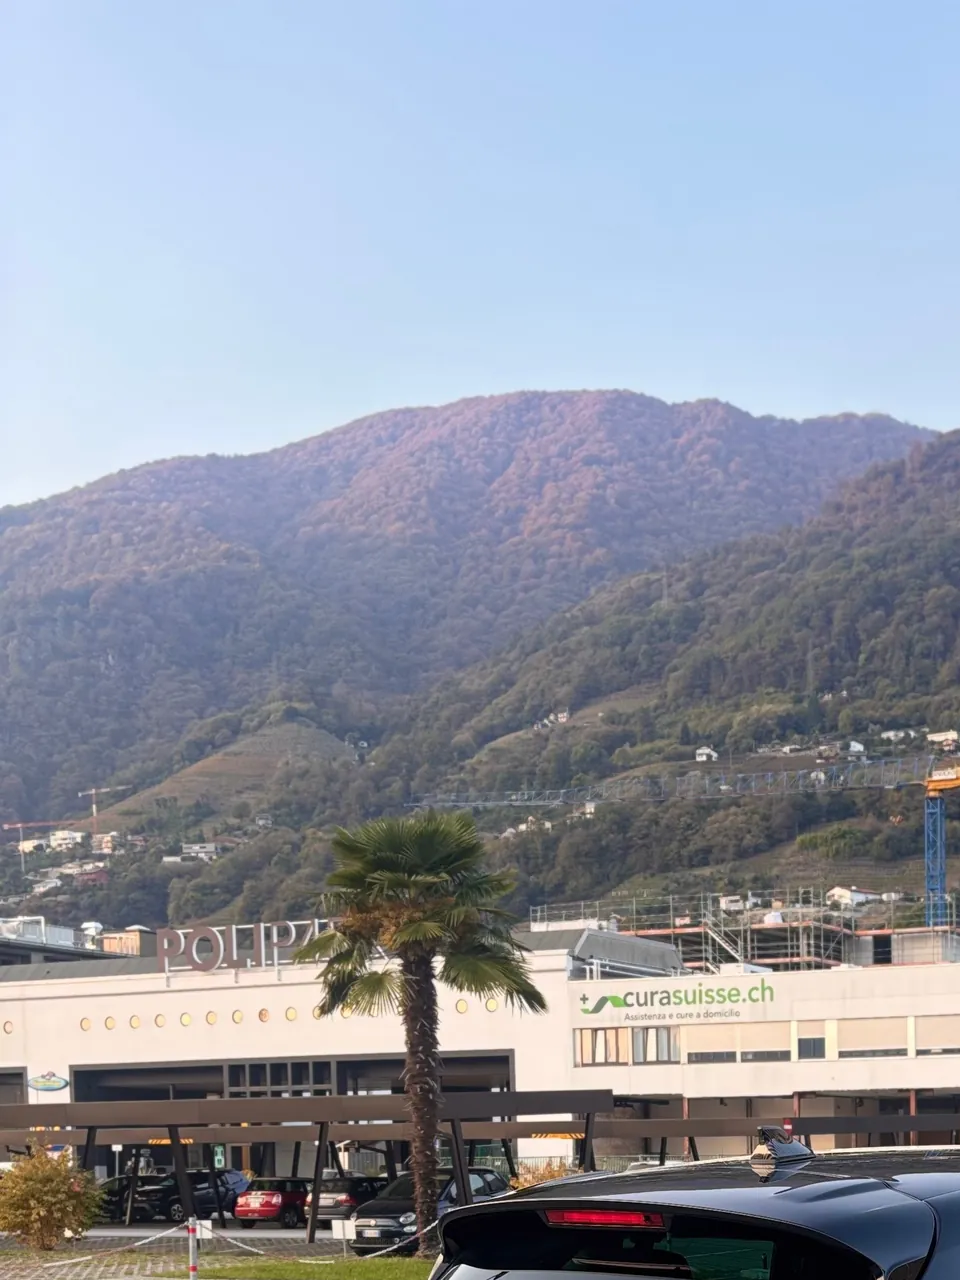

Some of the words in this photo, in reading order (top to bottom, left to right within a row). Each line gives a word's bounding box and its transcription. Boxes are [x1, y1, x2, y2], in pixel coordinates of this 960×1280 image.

[623, 978, 774, 1007] curasuisse.ch
[624, 1012, 666, 1021] Assistenza
[703, 1009, 741, 1018] domicilio
